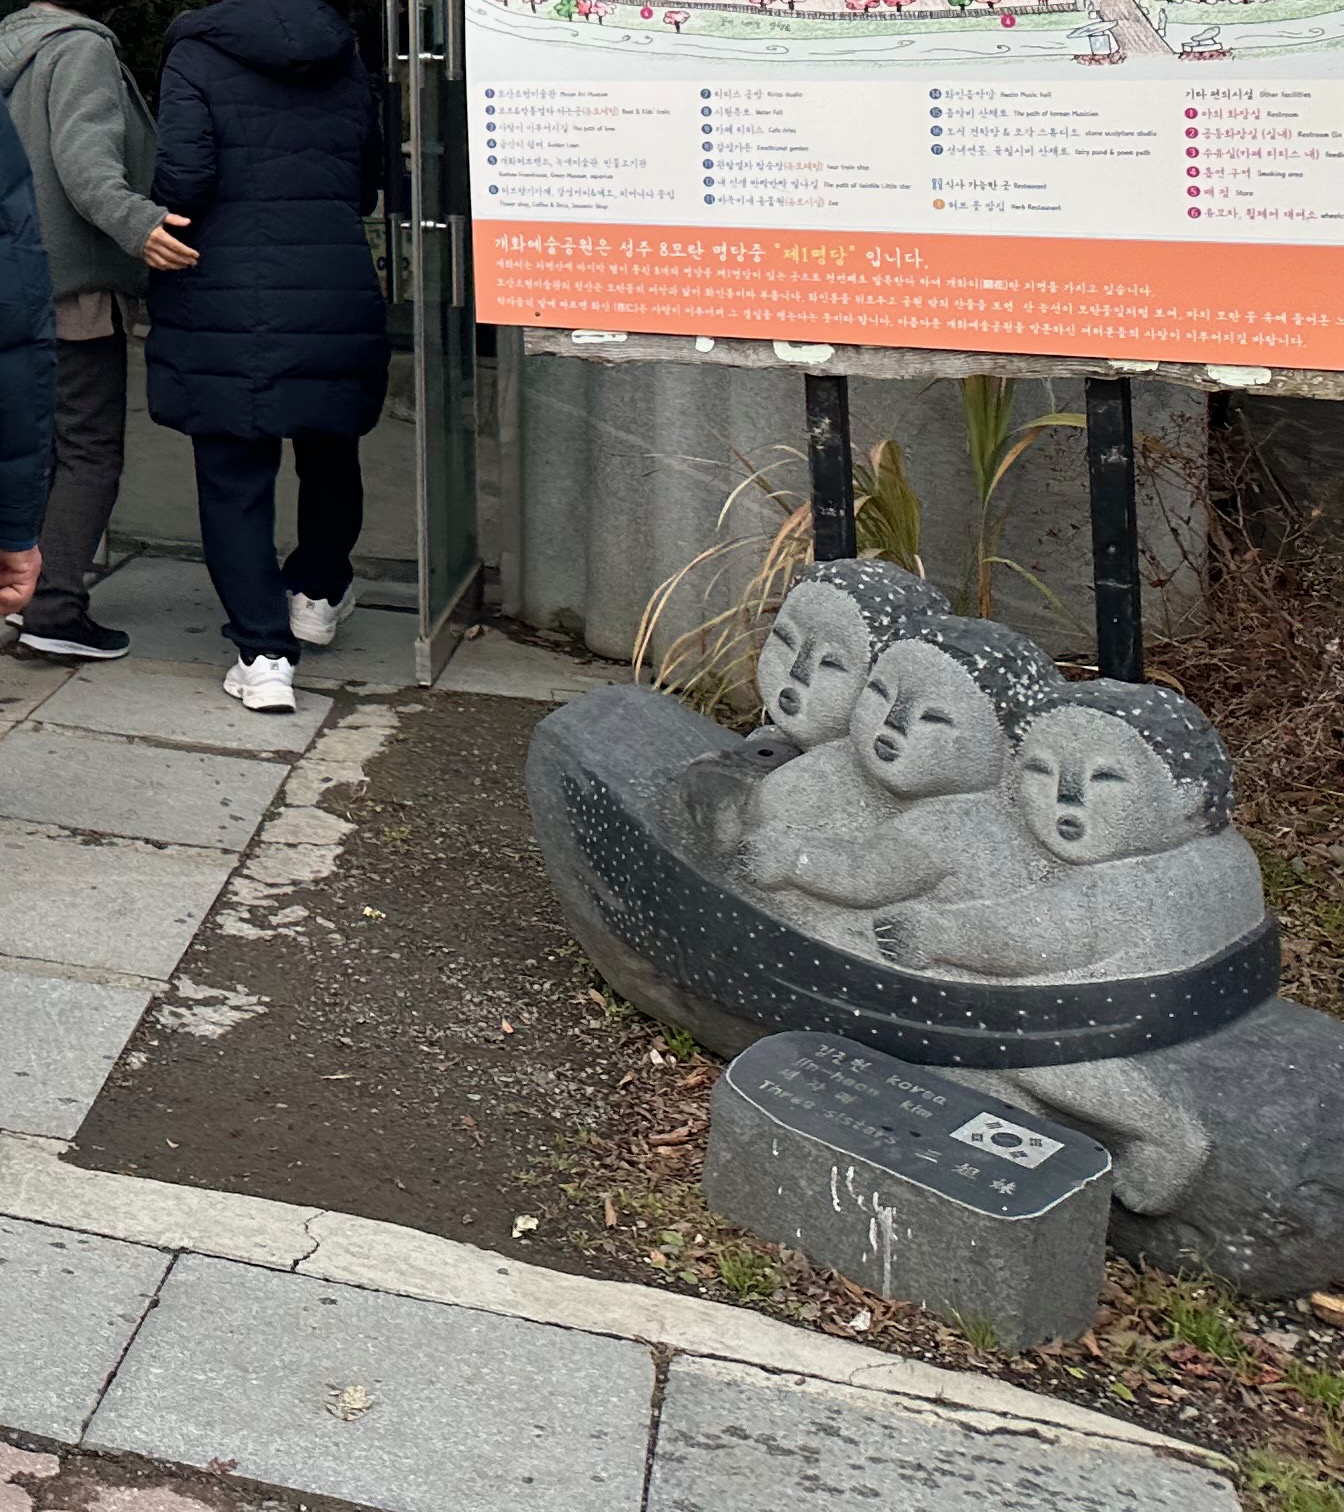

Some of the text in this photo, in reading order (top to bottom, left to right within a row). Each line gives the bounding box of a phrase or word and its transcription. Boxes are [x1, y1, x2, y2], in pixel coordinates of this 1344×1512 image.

[495, 234, 612, 256] 개화예술공원은
[619, 238, 653, 258] 성주
[712, 241, 766, 263] 명당중
[865, 247, 929, 269] 입니다.
